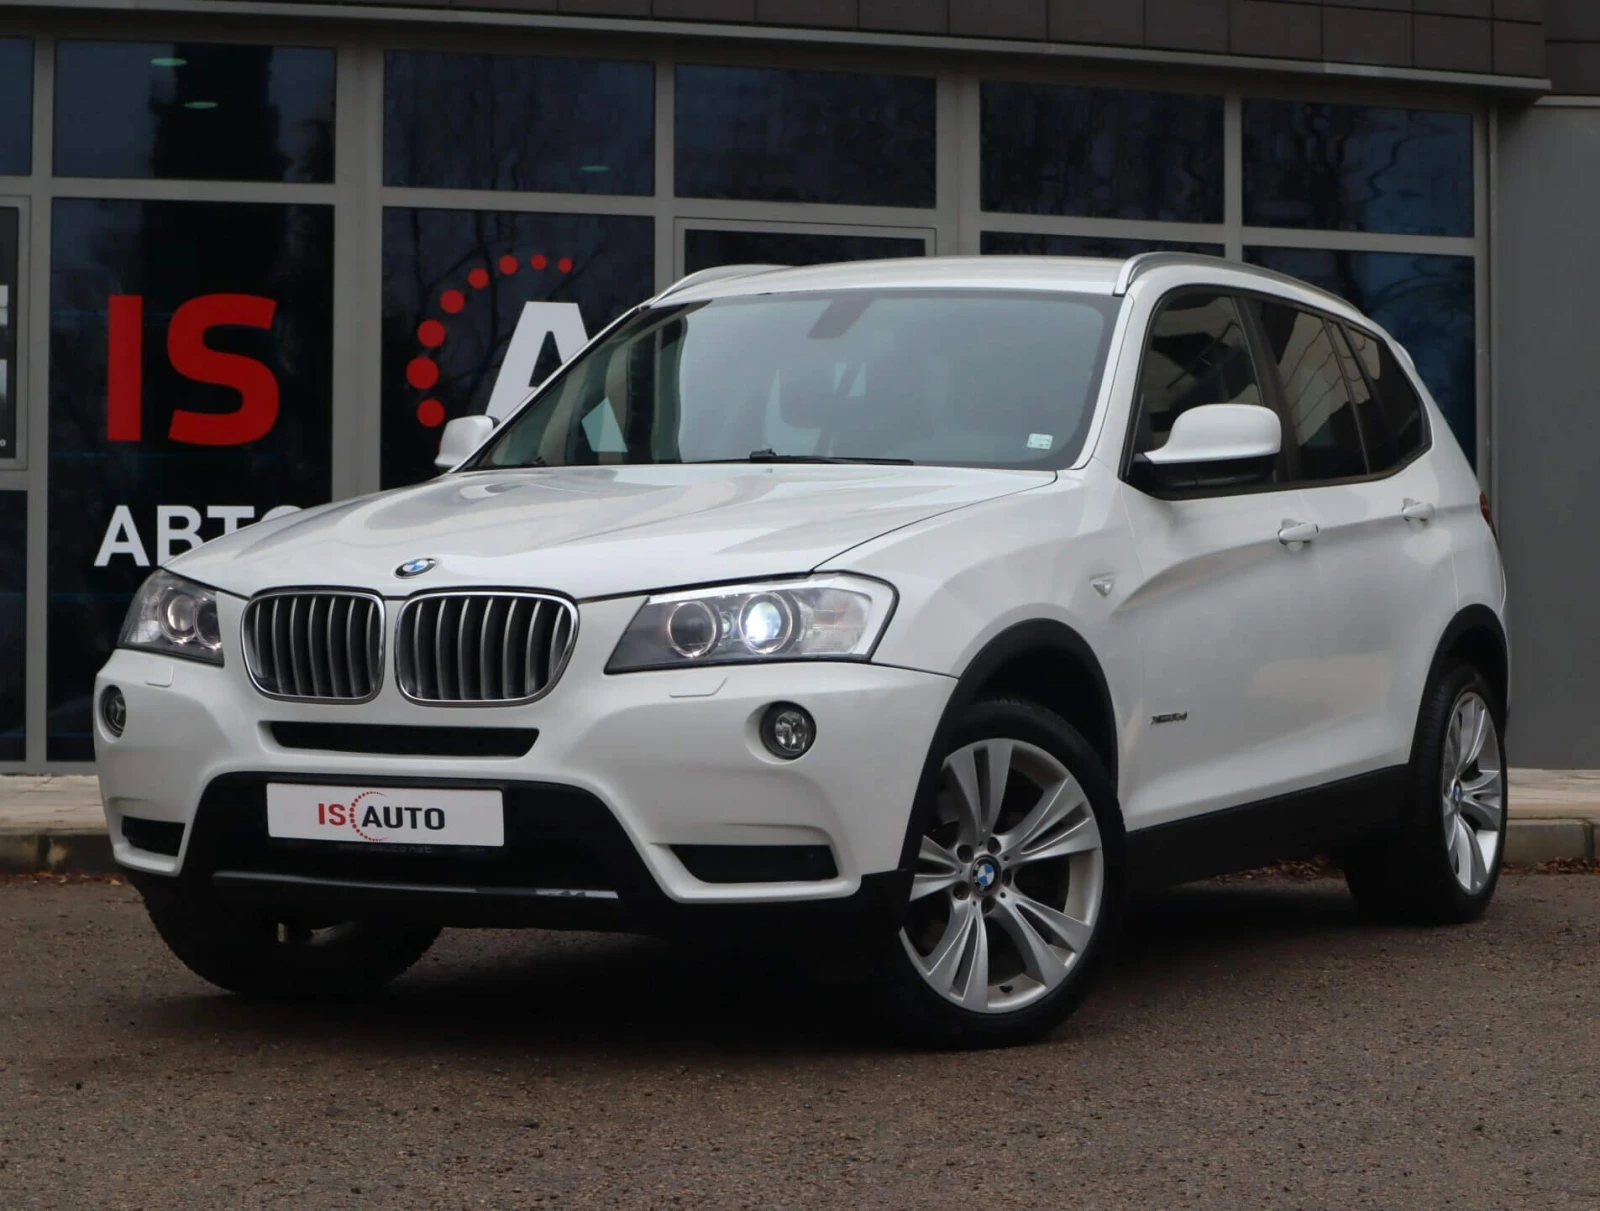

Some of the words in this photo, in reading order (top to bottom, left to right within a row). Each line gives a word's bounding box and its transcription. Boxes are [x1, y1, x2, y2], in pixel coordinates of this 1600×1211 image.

[106, 292, 280, 446] IS
[93, 504, 304, 567] АВТ
[317, 802, 347, 827] IS
[361, 805, 446, 831] AUTO
